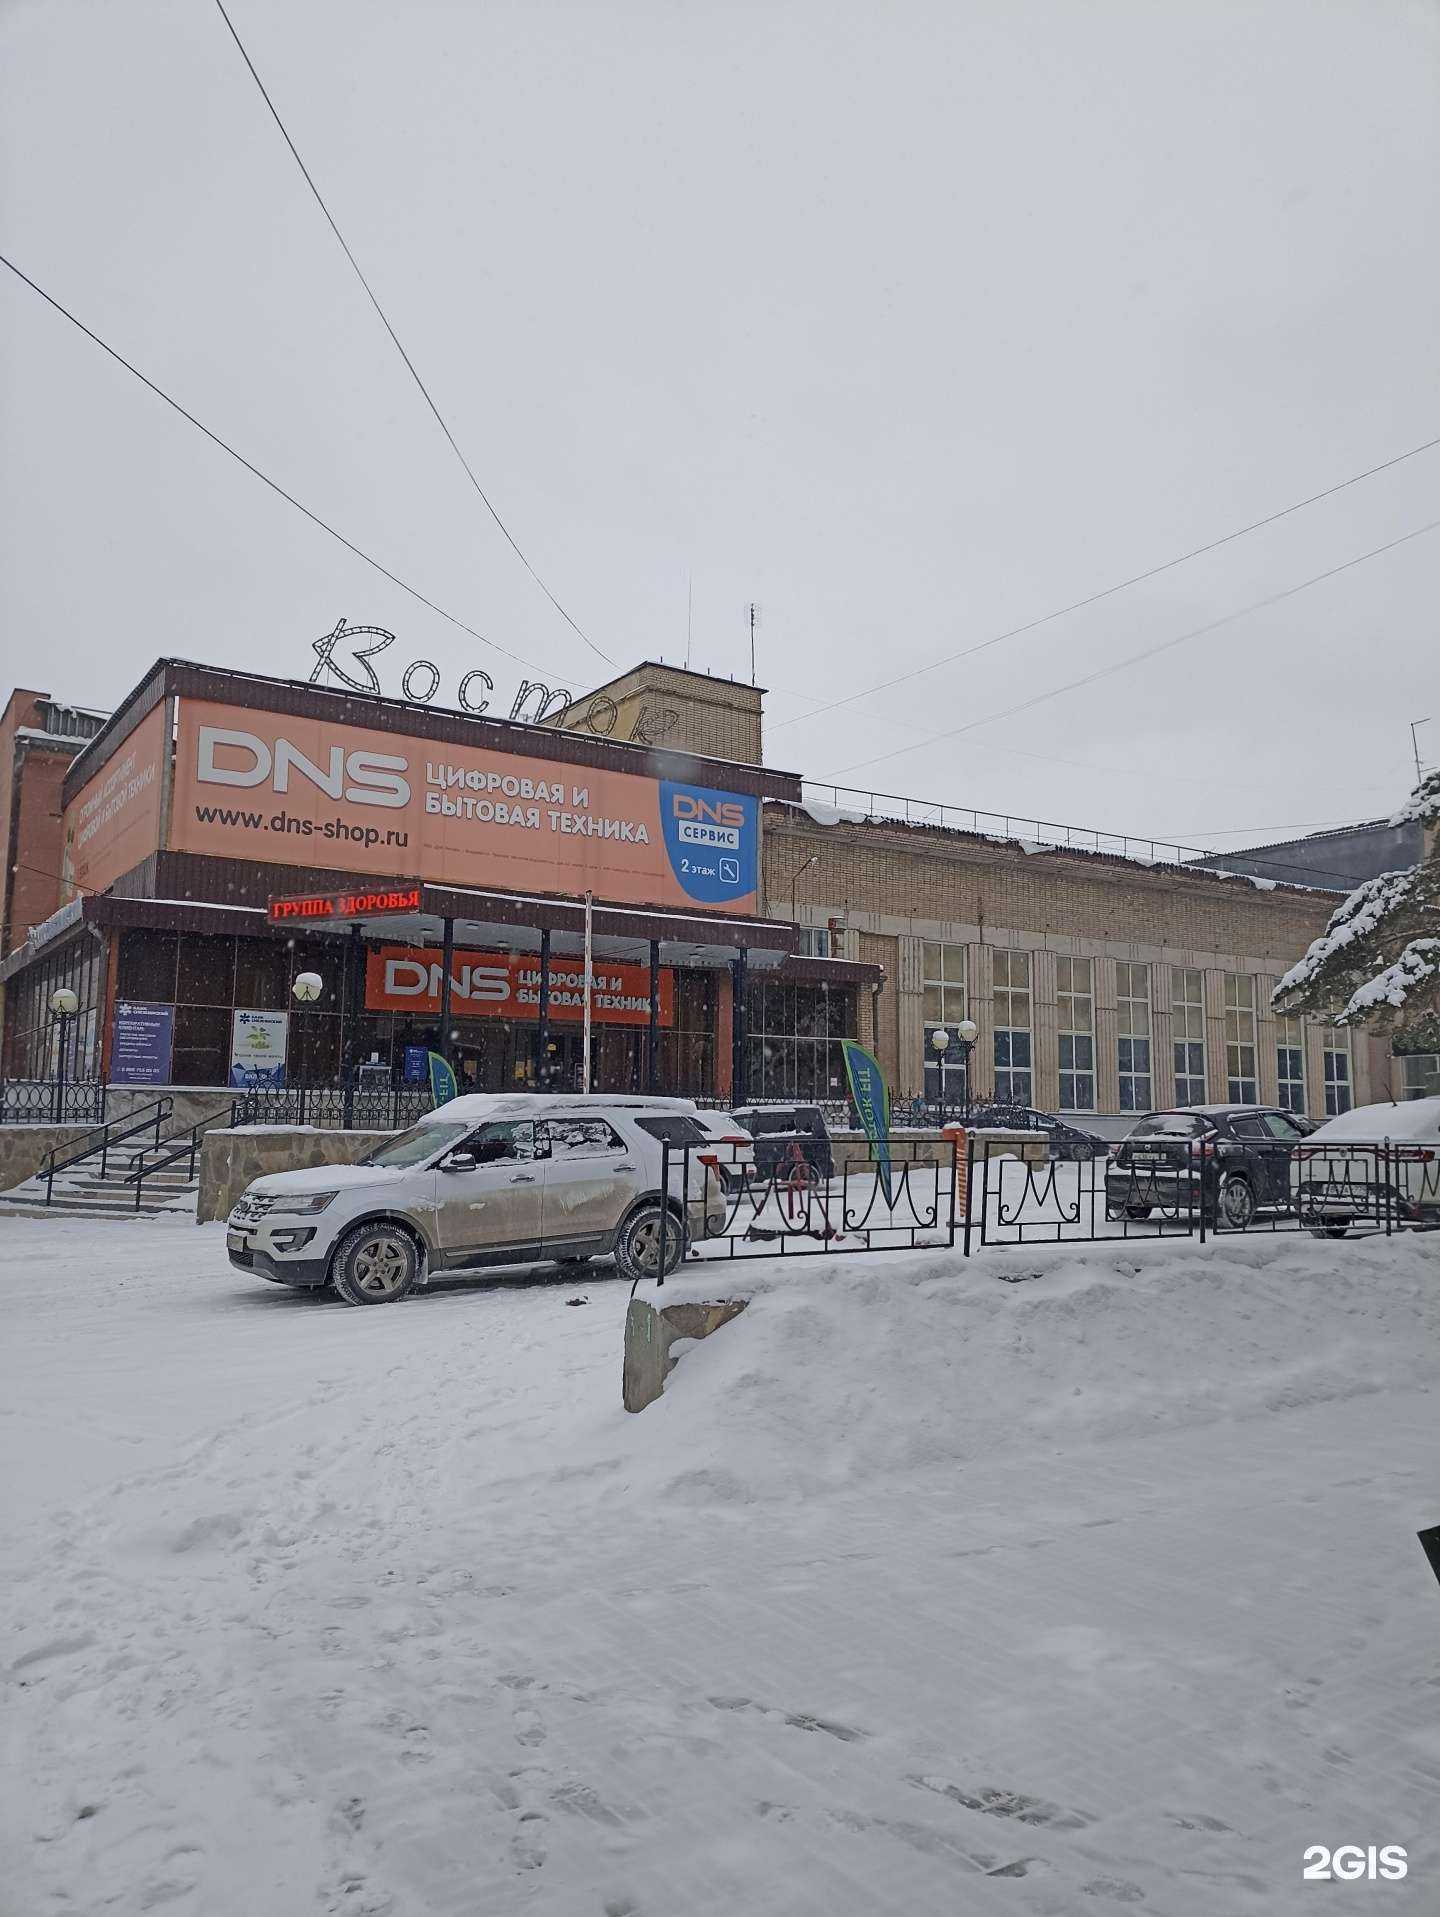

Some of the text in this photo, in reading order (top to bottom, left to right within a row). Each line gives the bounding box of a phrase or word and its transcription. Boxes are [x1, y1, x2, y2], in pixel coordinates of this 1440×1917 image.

[197, 725, 411, 809] DNS
[426, 761, 589, 808] ЦИФРОВАЯ И
[195, 804, 408, 848] www.dns-shop.ru
[425, 792, 649, 845] БЫТОВАЯ ТЕХНИКА
[673, 794, 745, 827] DNS
[683, 825, 735, 845] СЕРВИС
[681, 859, 689, 875] 2
[691, 864, 716, 878] этаж
[272, 890, 420, 918] ГРУППА ЗДОРОВЬЯ
[385, 959, 511, 1001] DNS
[611, 977, 622, 991] И
[594, 994, 661, 1012] ТЕХНИК
